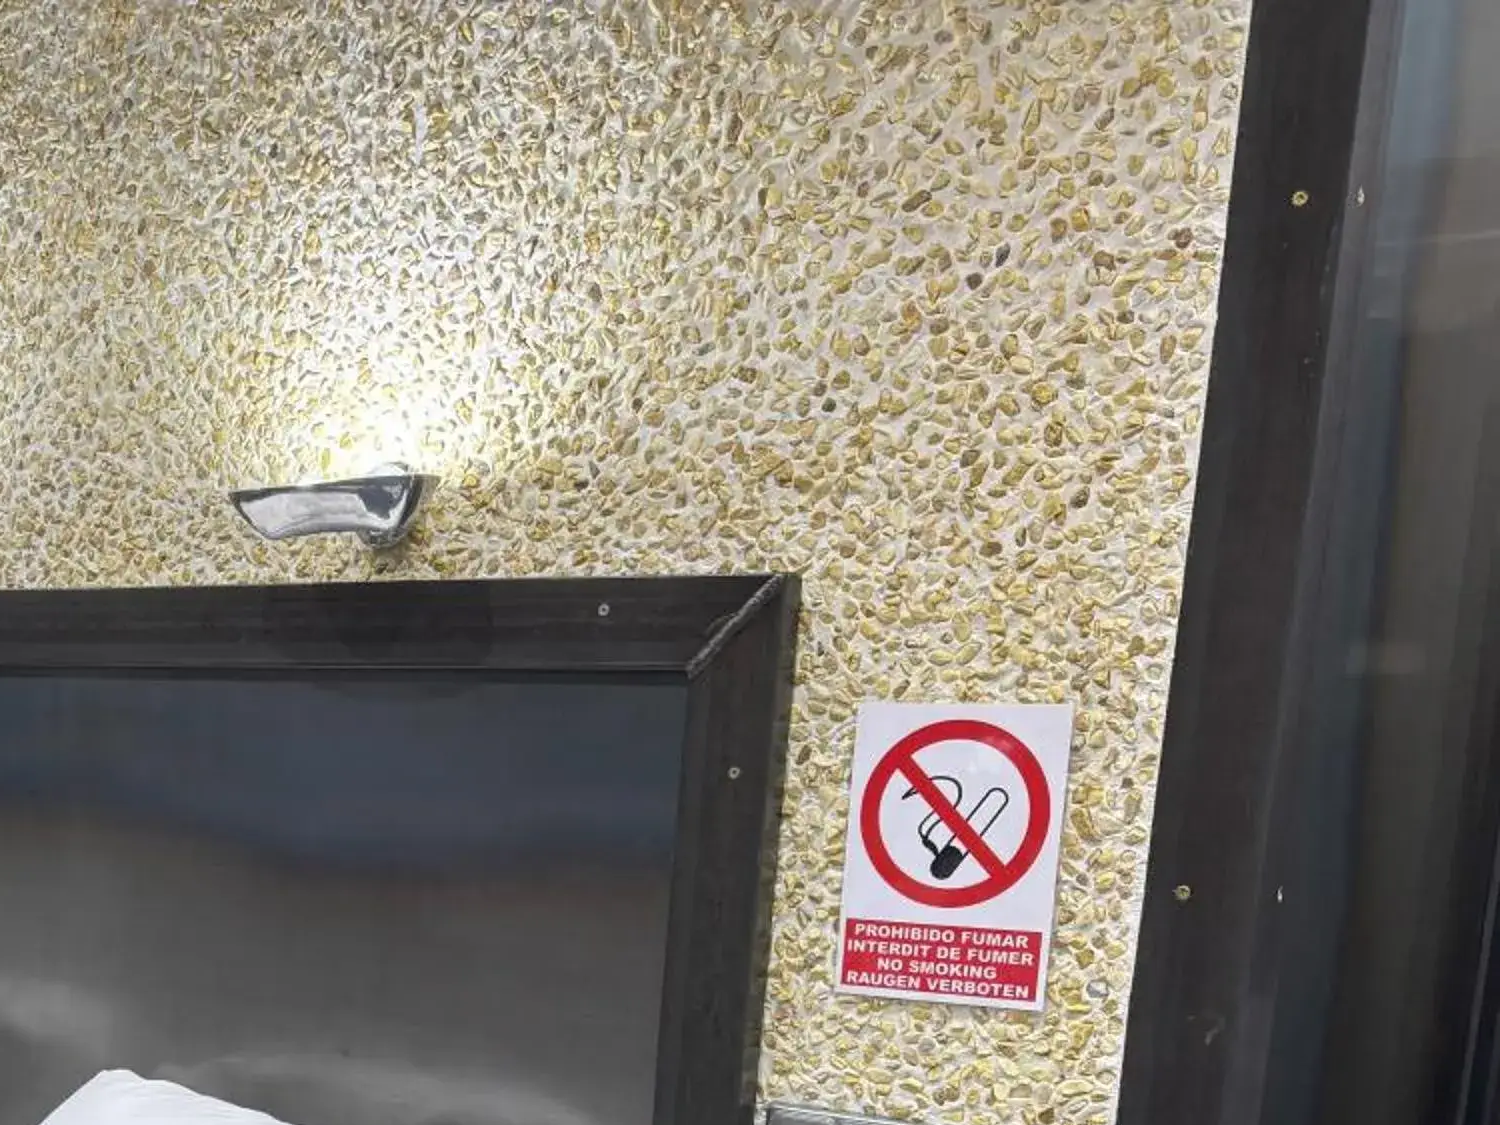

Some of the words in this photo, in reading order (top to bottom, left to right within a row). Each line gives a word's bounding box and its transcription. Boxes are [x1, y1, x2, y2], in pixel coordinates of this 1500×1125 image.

[855, 923, 955, 942] PROHIBIDO
[961, 931, 1029, 948] FUMAR
[847, 940, 932, 958] INTERDIT
[937, 947, 961, 961] DE
[967, 949, 1035, 966] FUMER
[877, 957, 903, 971] NO
[909, 961, 998, 980] SMOKING
[847, 970, 921, 989] RAUGEN
[927, 979, 1029, 999] VERBOTEN
